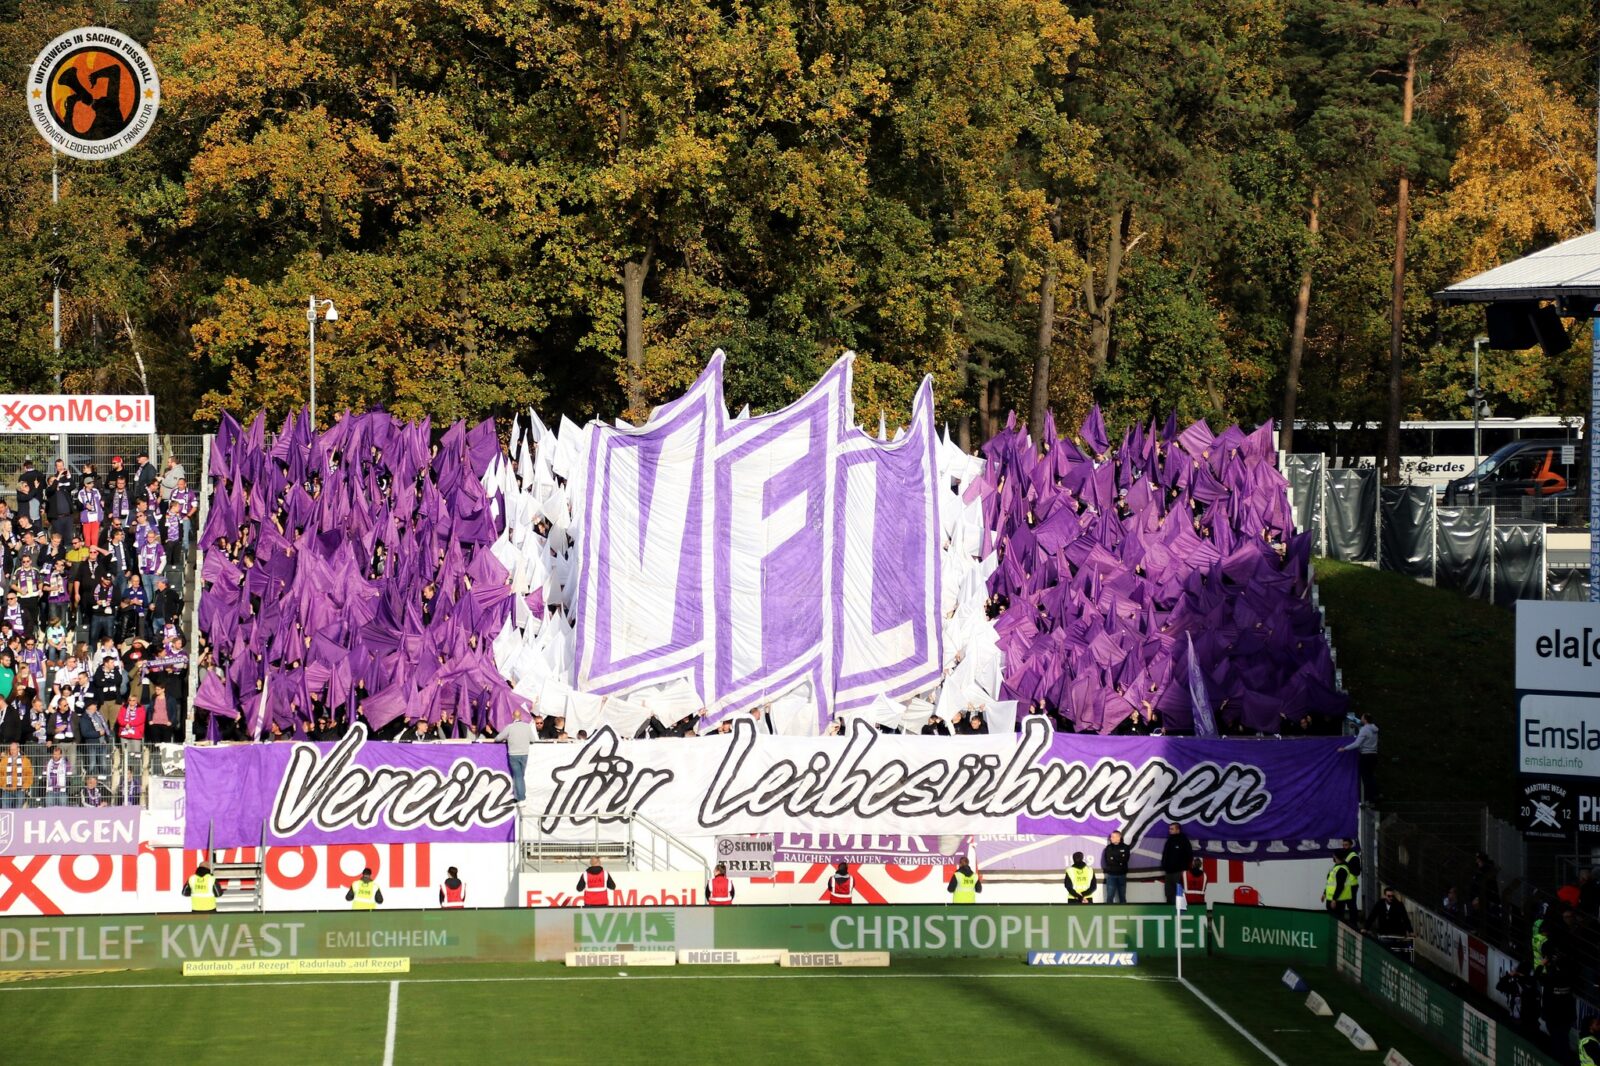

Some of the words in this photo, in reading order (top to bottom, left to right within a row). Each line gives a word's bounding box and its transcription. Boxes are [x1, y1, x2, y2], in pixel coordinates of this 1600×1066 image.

[1416, 461, 1465, 473] Gerdes
[1524, 755, 1584, 769] emsland.info
[163, 780, 181, 790] EIN
[273, 723, 517, 835] Verein
[541, 725, 674, 834] für
[698, 715, 1272, 849] Leibesübungen
[1524, 783, 1551, 796] MARITIME
[1550, 784, 1567, 798] WEAR
[1520, 806, 1531, 817] 20
[1561, 808, 1572, 820] 12
[23, 818, 134, 844] HAGEN
[157, 826, 182, 835] EINE
[734, 841, 773, 852] SEKTION
[718, 860, 772, 871] TRIER
[783, 852, 832, 864] RAUCHEN
[843, 855, 882, 865] SAUFEN
[893, 856, 956, 866] SCHMEISSEN
[574, 912, 642, 943] LVM
[829, 914, 1050, 951] CHRISTOPH
[1067, 914, 1225, 950] METTEN
[1, 925, 144, 962] DETLEF
[161, 922, 305, 960] KWAST
[325, 930, 448, 948] EMLICHHEIM
[1241, 925, 1318, 949] BAWINKEL
[299, 959, 347, 969] Radurlaub
[575, 953, 628, 967] NÖGEL
[688, 950, 741, 964] NÖGEL
[789, 952, 843, 967] NÖGEL
[1057, 952, 1111, 965] KUZKA
[186, 962, 233, 971] Radurlaub
